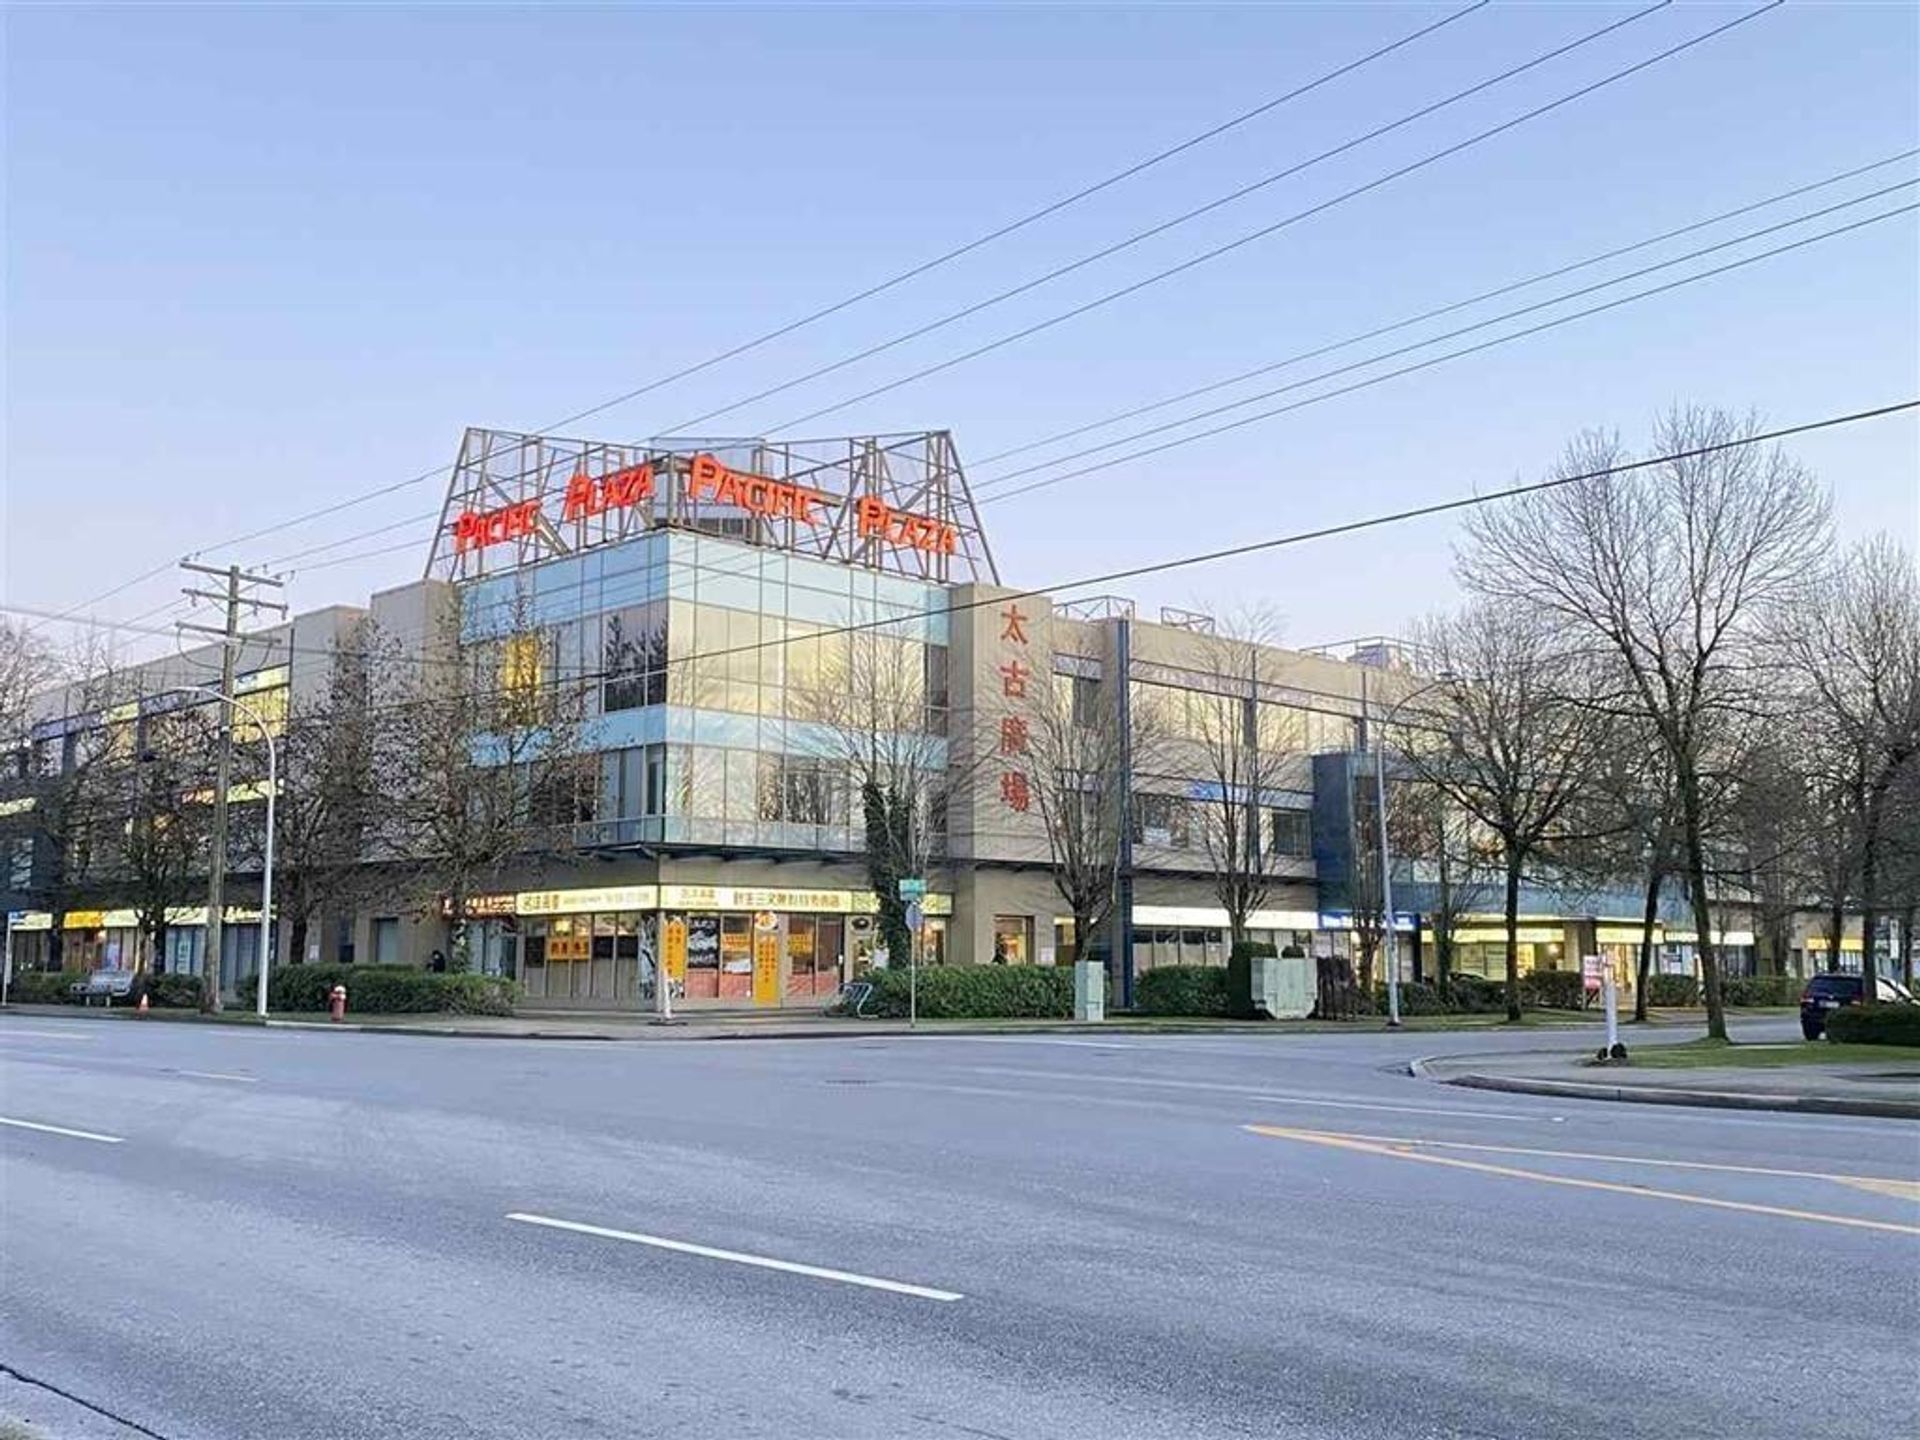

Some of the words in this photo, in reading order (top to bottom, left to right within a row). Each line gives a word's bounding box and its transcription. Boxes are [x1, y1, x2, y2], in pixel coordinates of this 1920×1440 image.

[455, 501, 541, 553] PACIFIC
[565, 465, 653, 522] PLAZA
[688, 453, 821, 526] PACIFIC
[857, 495, 956, 555] PLAZA
[1000, 603, 1030, 812] 太古廣場
